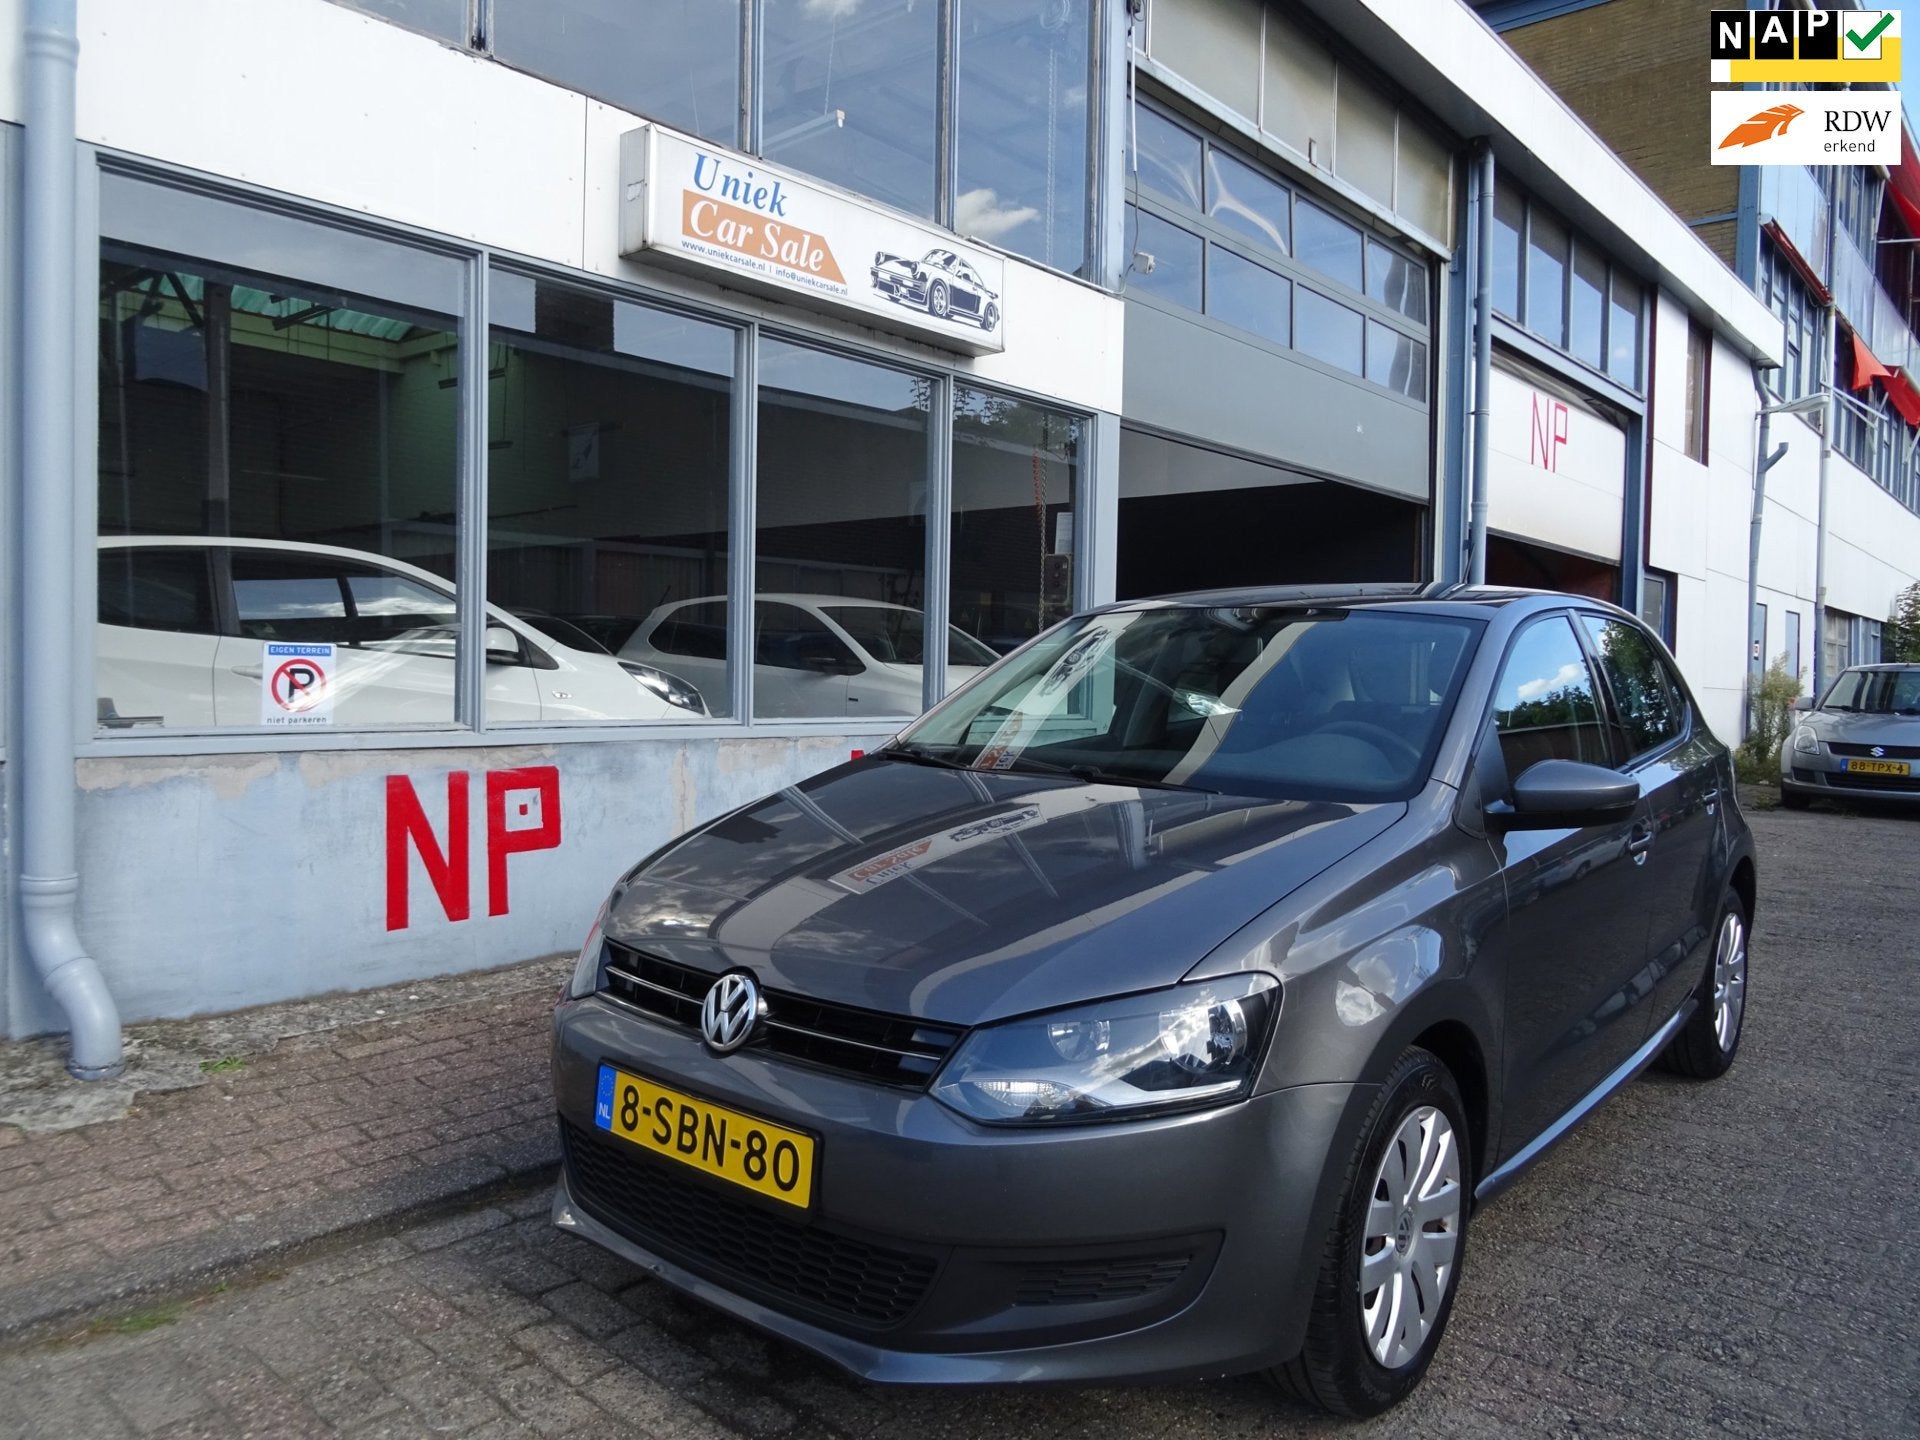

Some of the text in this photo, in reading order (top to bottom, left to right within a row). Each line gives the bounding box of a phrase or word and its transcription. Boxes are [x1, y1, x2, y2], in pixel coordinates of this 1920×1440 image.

[693, 153, 788, 217] Uniek
[690, 200, 824, 271] Car Sale
[682, 240, 765, 271] www.uniekcarsale.nl
[775, 267, 848, 296] info@uniekcarsale.nl
[1531, 392, 1568, 473] NP
[270, 646, 330, 655] EIGEN TERREIN
[267, 716, 327, 725] niet parkeren
[1851, 762, 1904, 774] 88-TPX-4
[386, 765, 561, 932] NP
[598, 1102, 611, 1119] NL
[620, 1085, 800, 1192] 8-SBN-80
